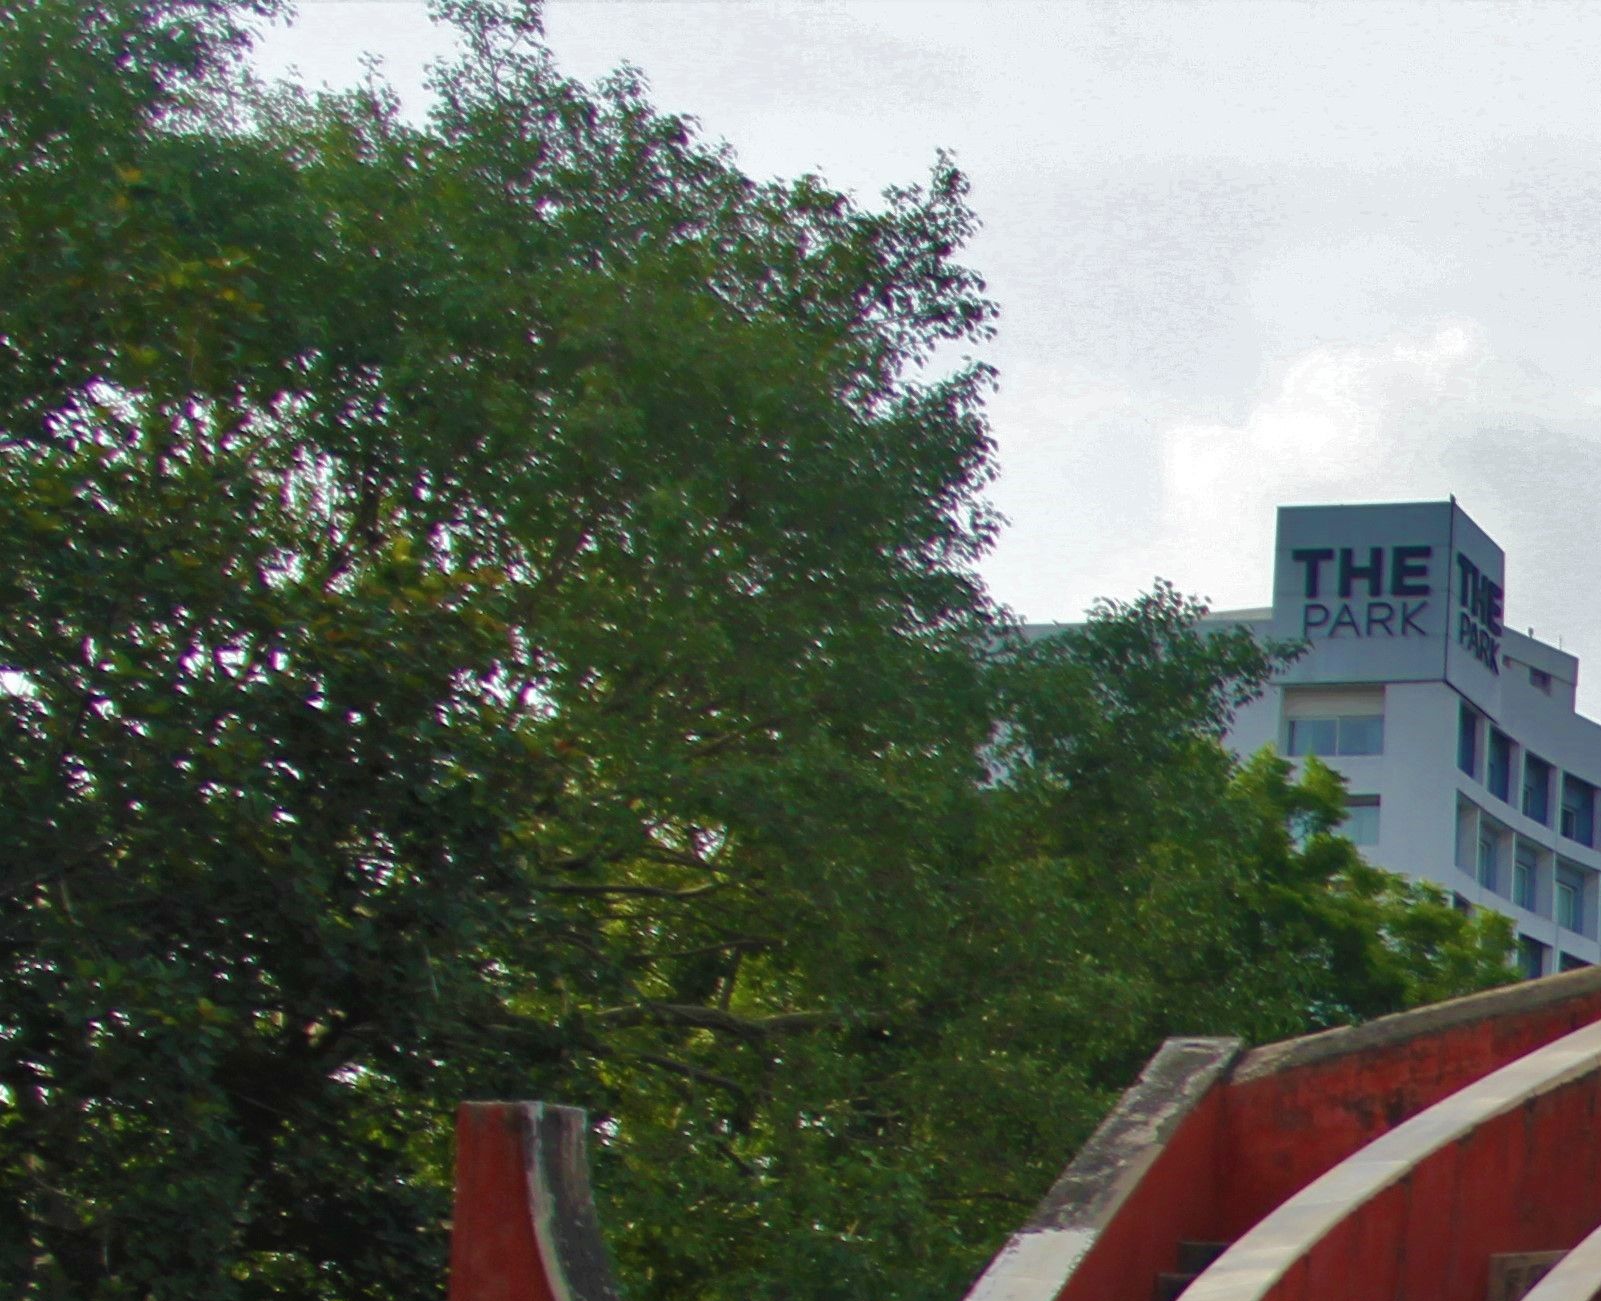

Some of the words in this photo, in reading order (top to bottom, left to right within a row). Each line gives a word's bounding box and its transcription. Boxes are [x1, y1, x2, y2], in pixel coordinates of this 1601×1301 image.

[1291, 545, 1432, 598] THE
[1457, 551, 1503, 637] THE
[1303, 601, 1428, 638] PARK
[1458, 611, 1500, 676] PARK
